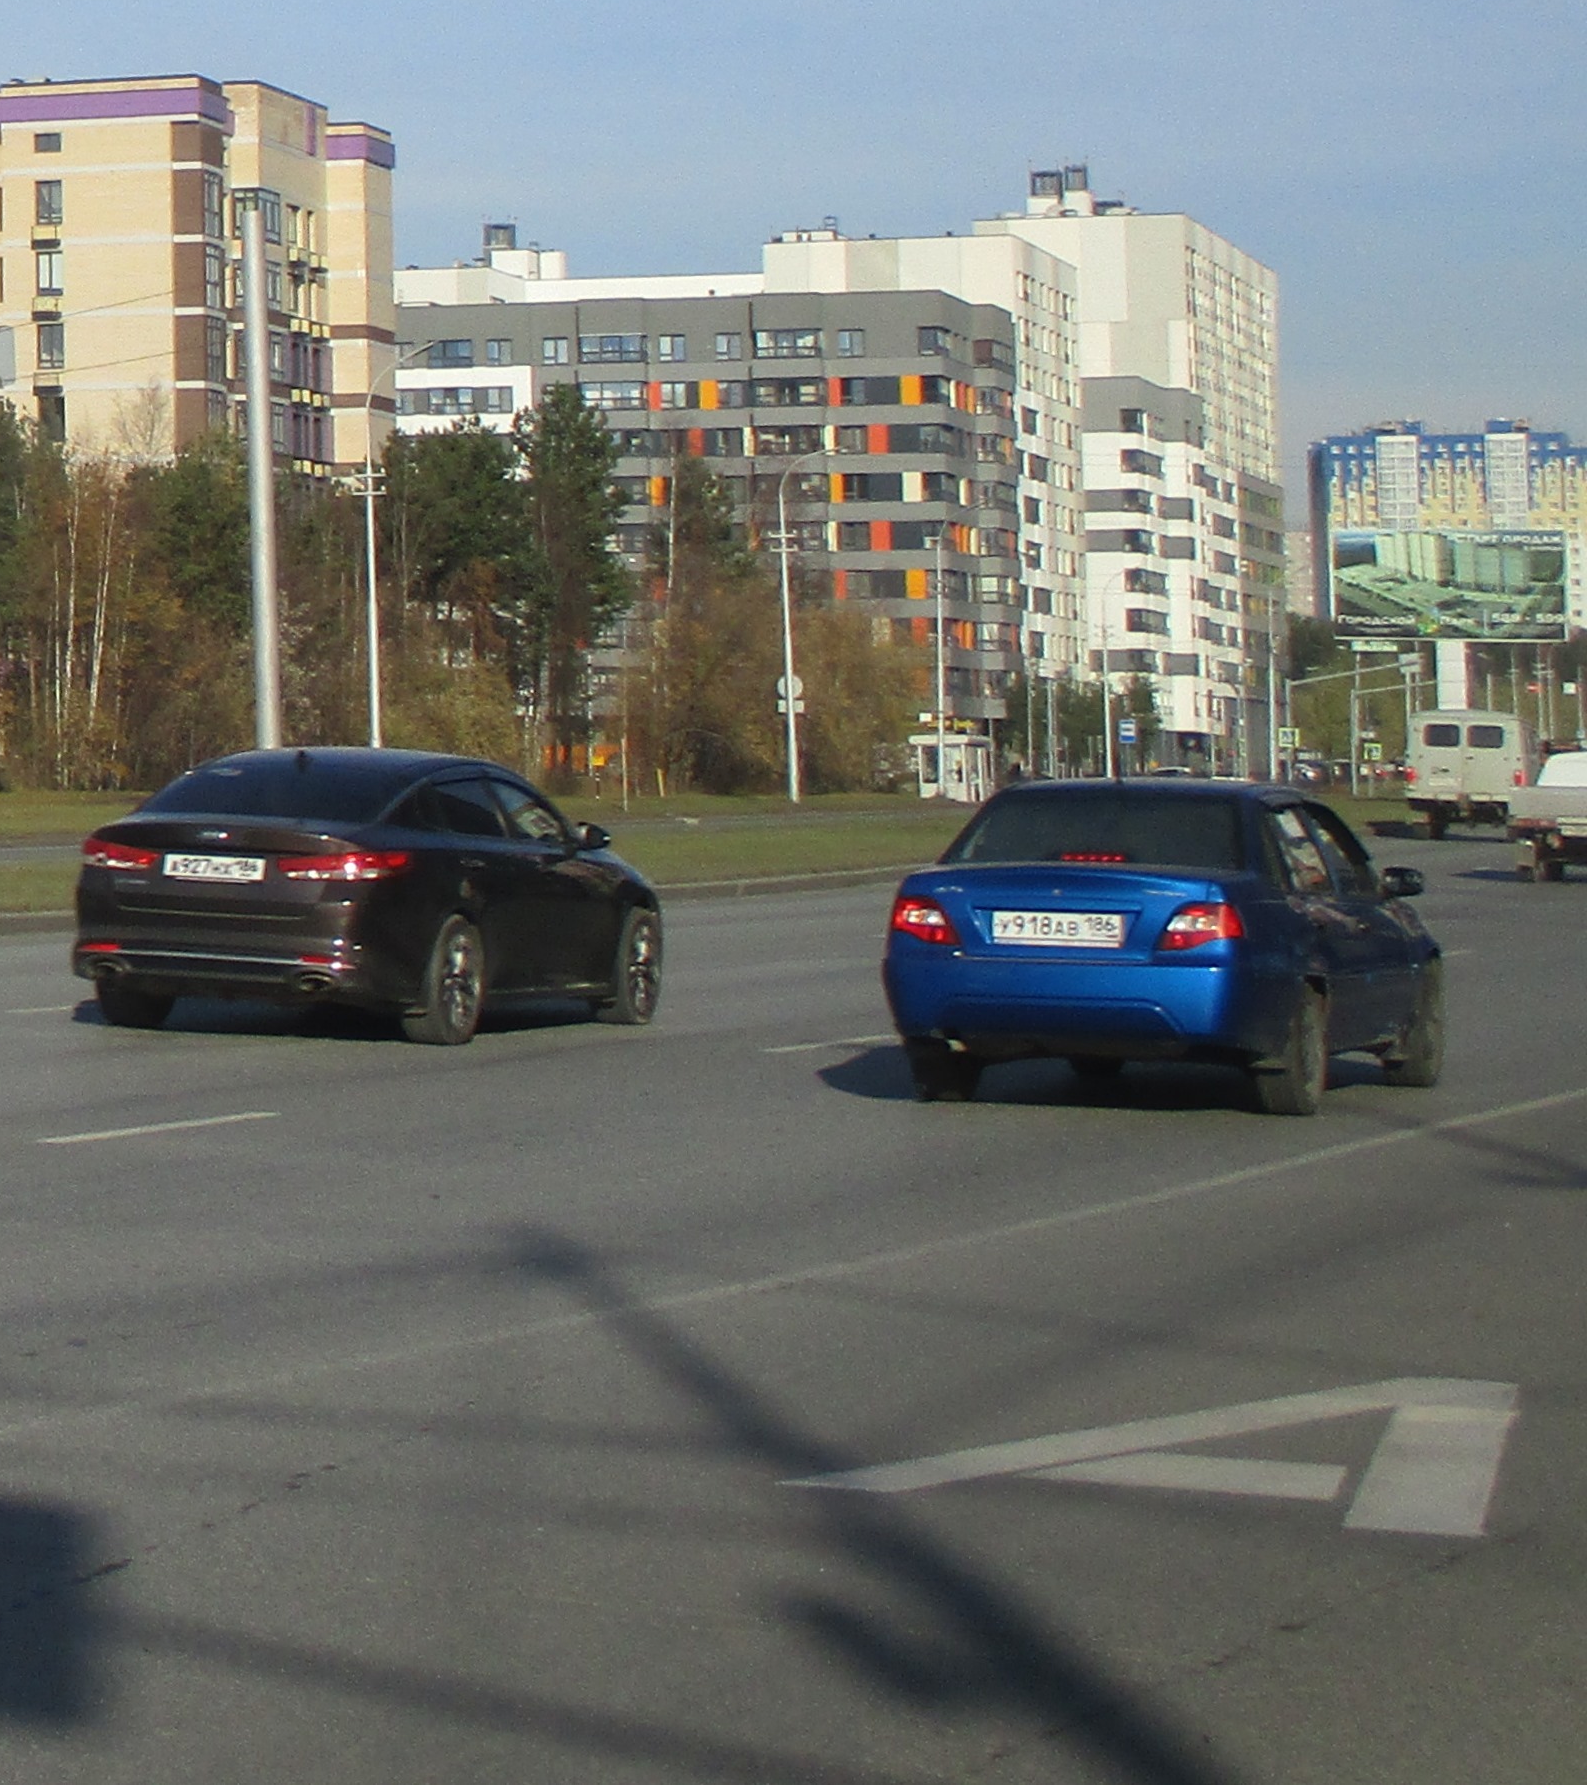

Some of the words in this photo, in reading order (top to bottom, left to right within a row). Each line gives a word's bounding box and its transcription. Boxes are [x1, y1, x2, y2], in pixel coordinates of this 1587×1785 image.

[1502, 534, 1562, 544] ПРОДАЖ
[1000, 915, 1079, 936] У918АВ
[1086, 917, 1115, 932] 186
